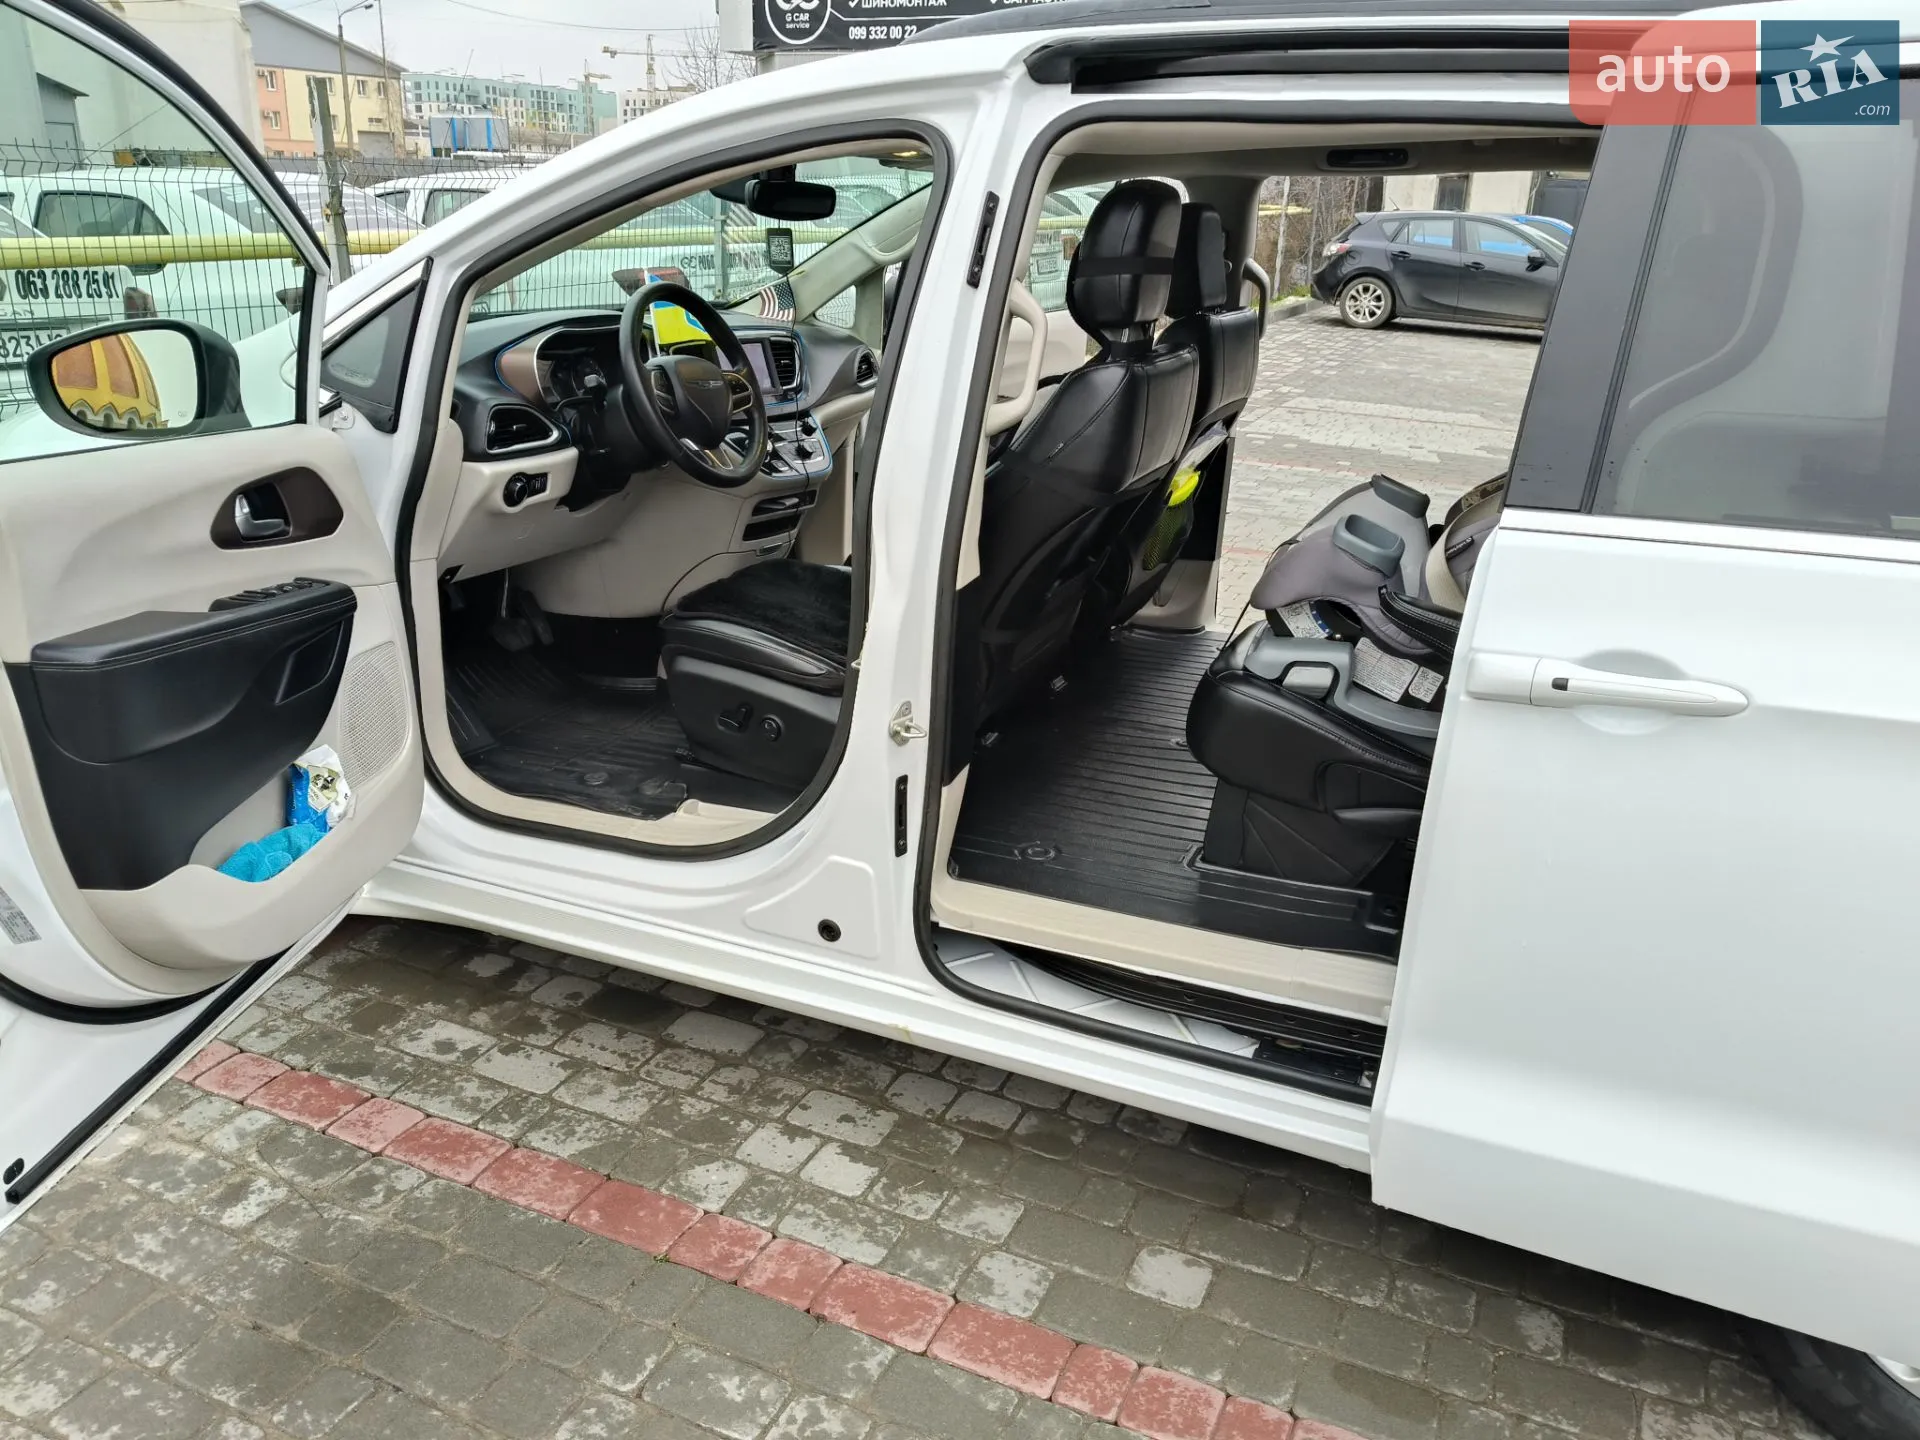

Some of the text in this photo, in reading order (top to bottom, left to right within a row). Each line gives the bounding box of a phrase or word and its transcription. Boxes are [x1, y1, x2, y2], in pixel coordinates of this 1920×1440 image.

[785, 13, 810, 22] G CAR
[849, 26, 867, 40] 099
[868, 26, 887, 39] 332
[889, 26, 902, 39] 00
[15, 269, 119, 300] 063 288 25 91
